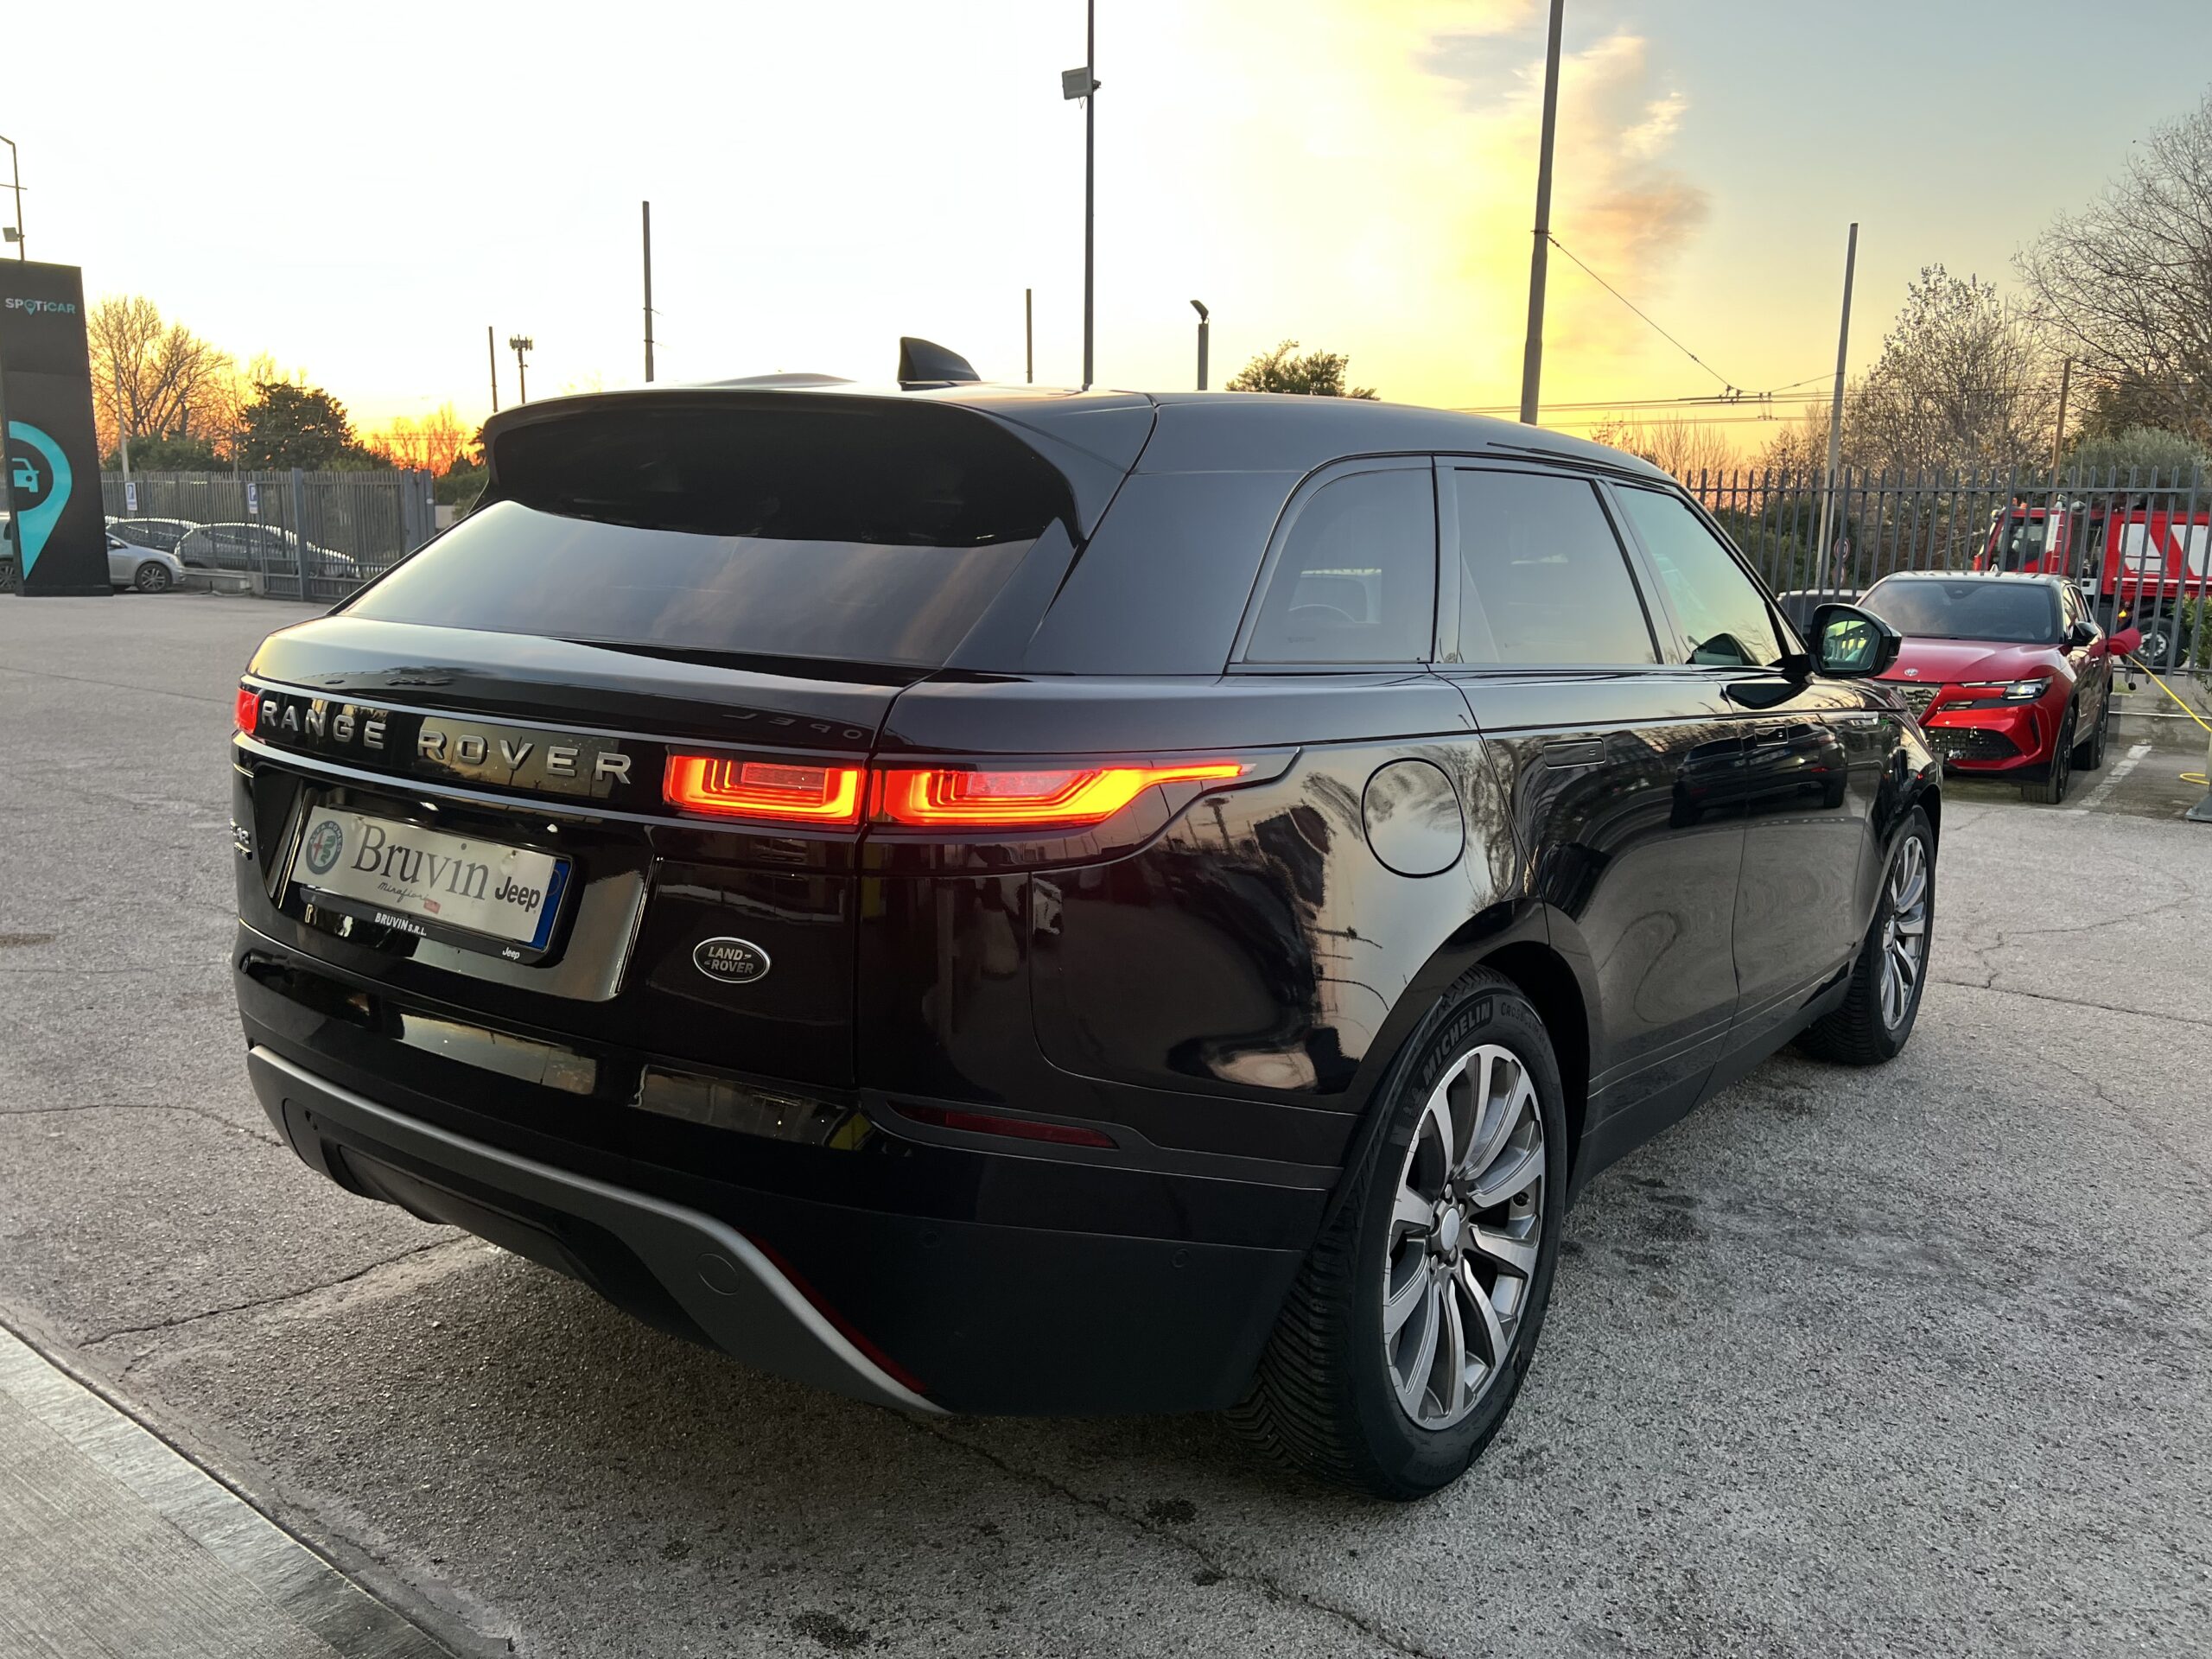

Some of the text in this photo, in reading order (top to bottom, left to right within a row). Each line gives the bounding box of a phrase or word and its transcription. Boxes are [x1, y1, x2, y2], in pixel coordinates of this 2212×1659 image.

[261, 700, 632, 785] RANGE ROVER
[350, 823, 489, 900] Bruvin
[374, 912, 409, 931] BRUVIN
[495, 876, 540, 912] Jeep
[502, 946, 520, 960] Jeep
[1422, 1001, 1491, 1085] MICHELIN
